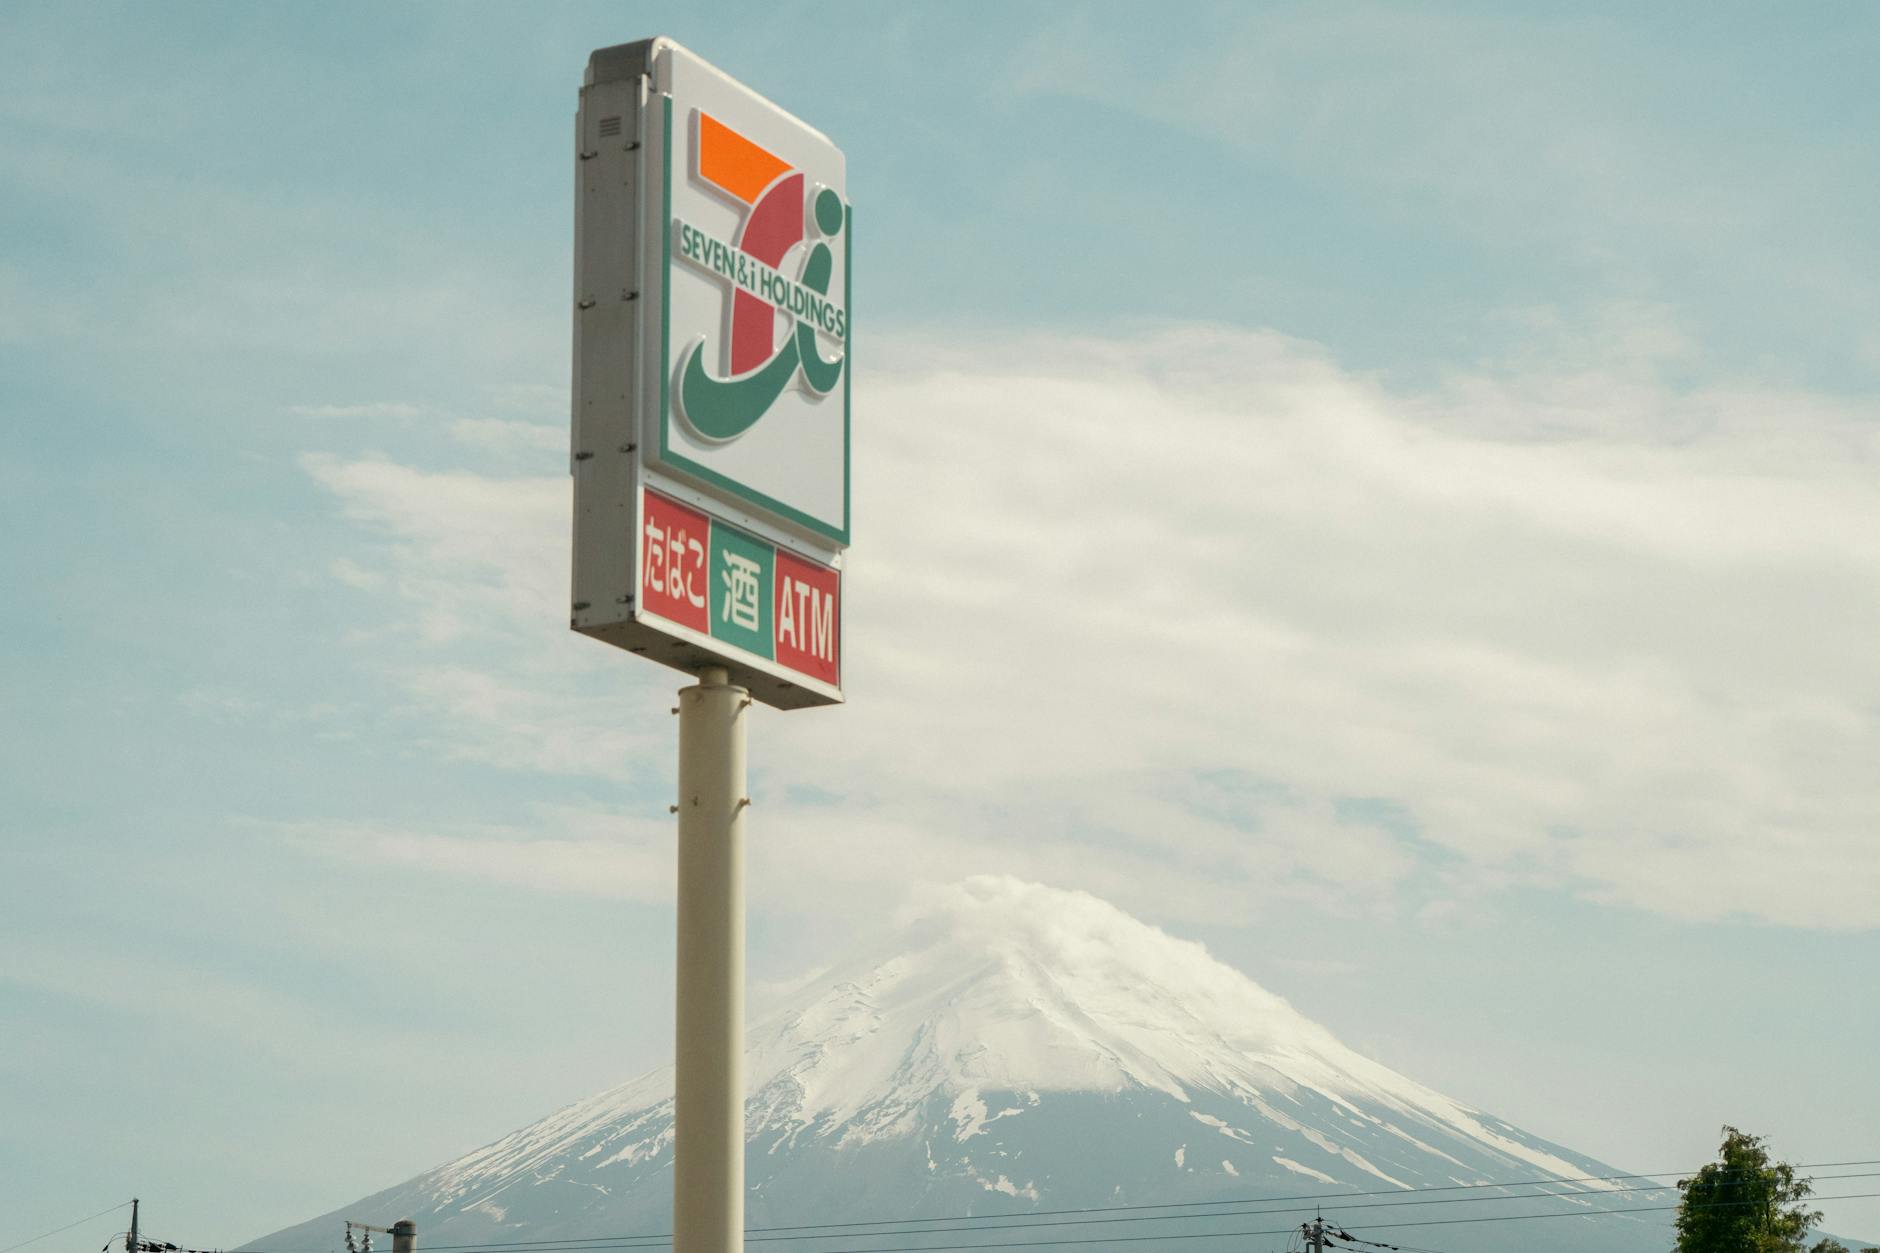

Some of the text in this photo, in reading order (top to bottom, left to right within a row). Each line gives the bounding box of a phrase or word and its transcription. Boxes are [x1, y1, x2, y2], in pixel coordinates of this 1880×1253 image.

[760, 266, 844, 338] HOLDINGS
[645, 516, 705, 608] たばこ
[721, 549, 761, 632] 酒
[778, 575, 833, 663] ATM
